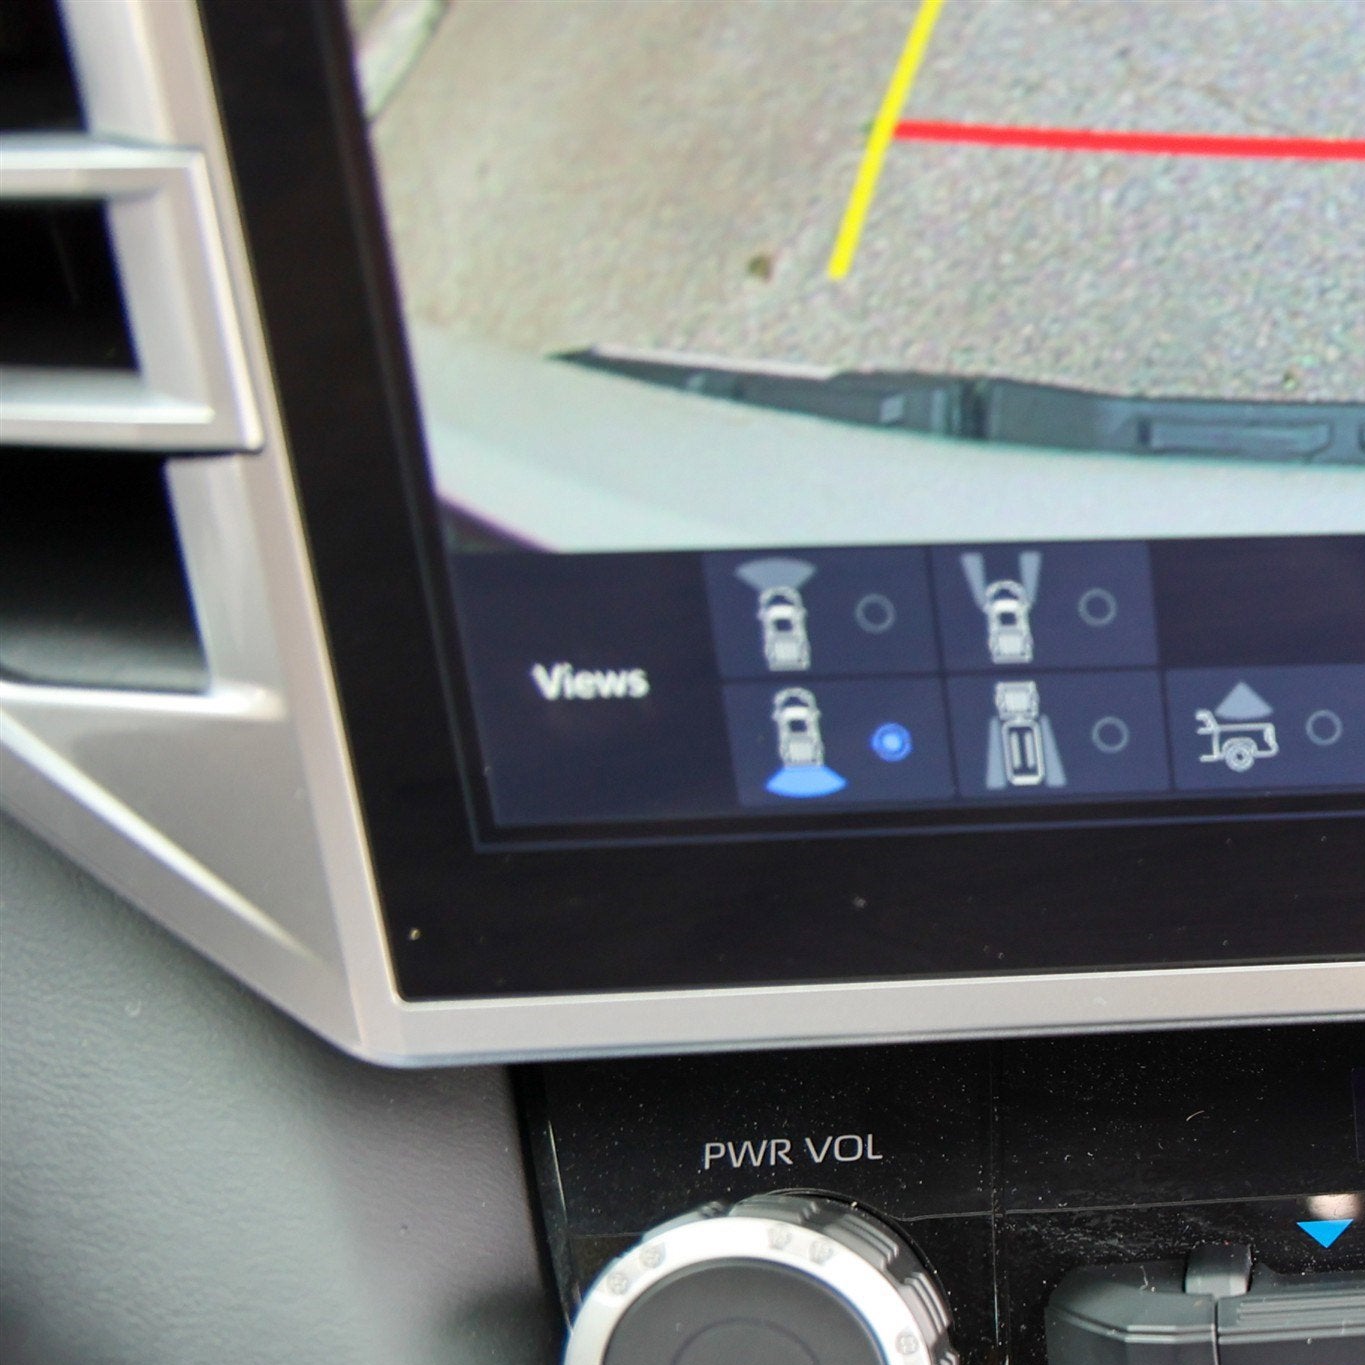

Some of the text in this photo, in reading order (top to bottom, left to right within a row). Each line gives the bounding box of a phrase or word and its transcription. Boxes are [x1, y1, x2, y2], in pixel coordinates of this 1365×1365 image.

[532, 663, 649, 700] Views
[704, 1133, 883, 1170] PWR VOL
